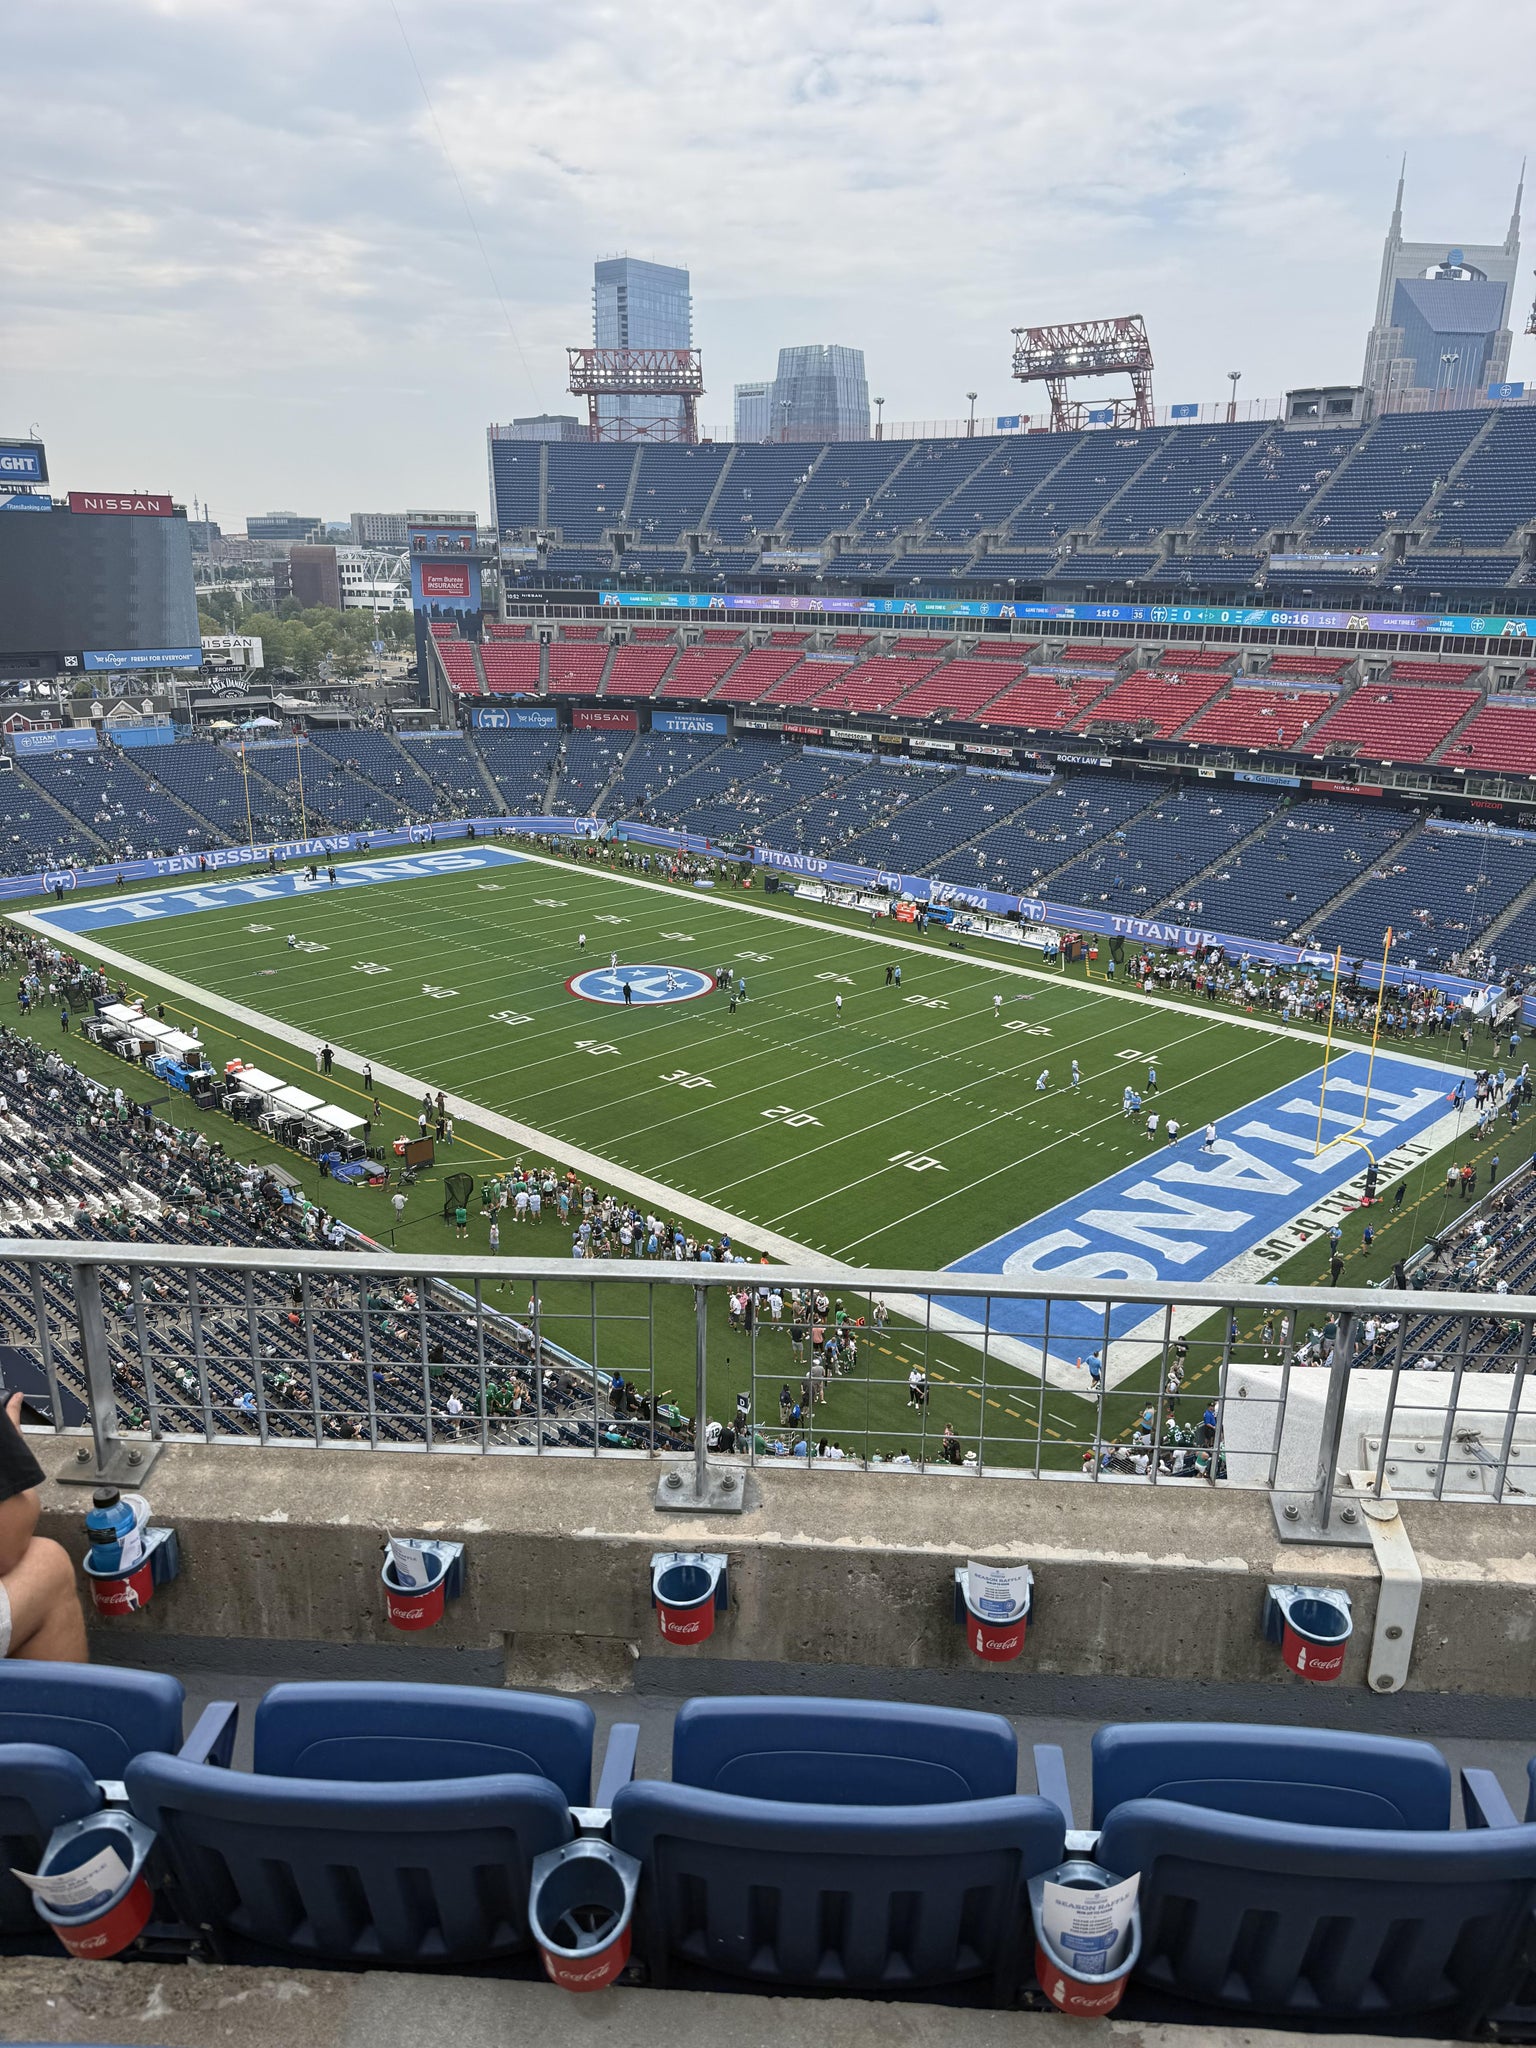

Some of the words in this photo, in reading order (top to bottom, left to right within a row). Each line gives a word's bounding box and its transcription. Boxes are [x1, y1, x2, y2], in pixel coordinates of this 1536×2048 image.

[0, 457, 34, 471] GHT
[6, 503, 50, 512] TitansBanking.com
[85, 498, 160, 511] NISSAN
[1096, 609, 1110, 617] 1st
[1112, 609, 1119, 618] &
[1183, 610, 1191, 621] 0
[1221, 611, 1229, 622] 0
[1271, 613, 1309, 625] 69:16
[1319, 616, 1336, 625] 1st
[105, 654, 127, 666] Kroger
[211, 680, 227, 694] JACK
[528, 711, 554, 727] Kroger
[581, 712, 629, 722] NISSAN
[666, 720, 714, 732] TITANS
[1025, 751, 1042, 759] FedEx
[1057, 754, 1081, 763] ROCKY
[1082, 757, 1098, 765] LAW
[1255, 775, 1291, 785] Gallagher
[1471, 801, 1503, 810] verizon
[153, 845, 278, 874] TENNESSEE
[284, 836, 350, 856] TITANS
[758, 849, 804, 870] TITAN
[806, 858, 828, 874] UP
[85, 854, 487, 919] TITANS
[1110, 915, 1181, 942] TITAN
[1184, 928, 1219, 948] UP
[351, 960, 393, 975] 30
[421, 983, 461, 999] 40
[903, 994, 950, 1010] 30
[488, 1010, 535, 1026] 50
[1001, 1020, 1054, 1037] 20
[573, 1039, 614, 1056] 40
[1113, 1048, 1162, 1065] 10
[658, 1069, 710, 1089] 30
[760, 1105, 818, 1128] 20
[1409, 1142, 1433, 1158] IT
[888, 1150, 940, 1172] 10
[1002, 1077, 1447, 1315] TITANS
[1312, 1190, 1360, 1216] ALL
[1288, 1217, 1328, 1241] OF
[1253, 1238, 1297, 1262] US
[711, 1427, 720, 1439] 12
[1055, 1899, 1096, 1911] SEASON
[1098, 1893, 1131, 1911] RAFFLE
